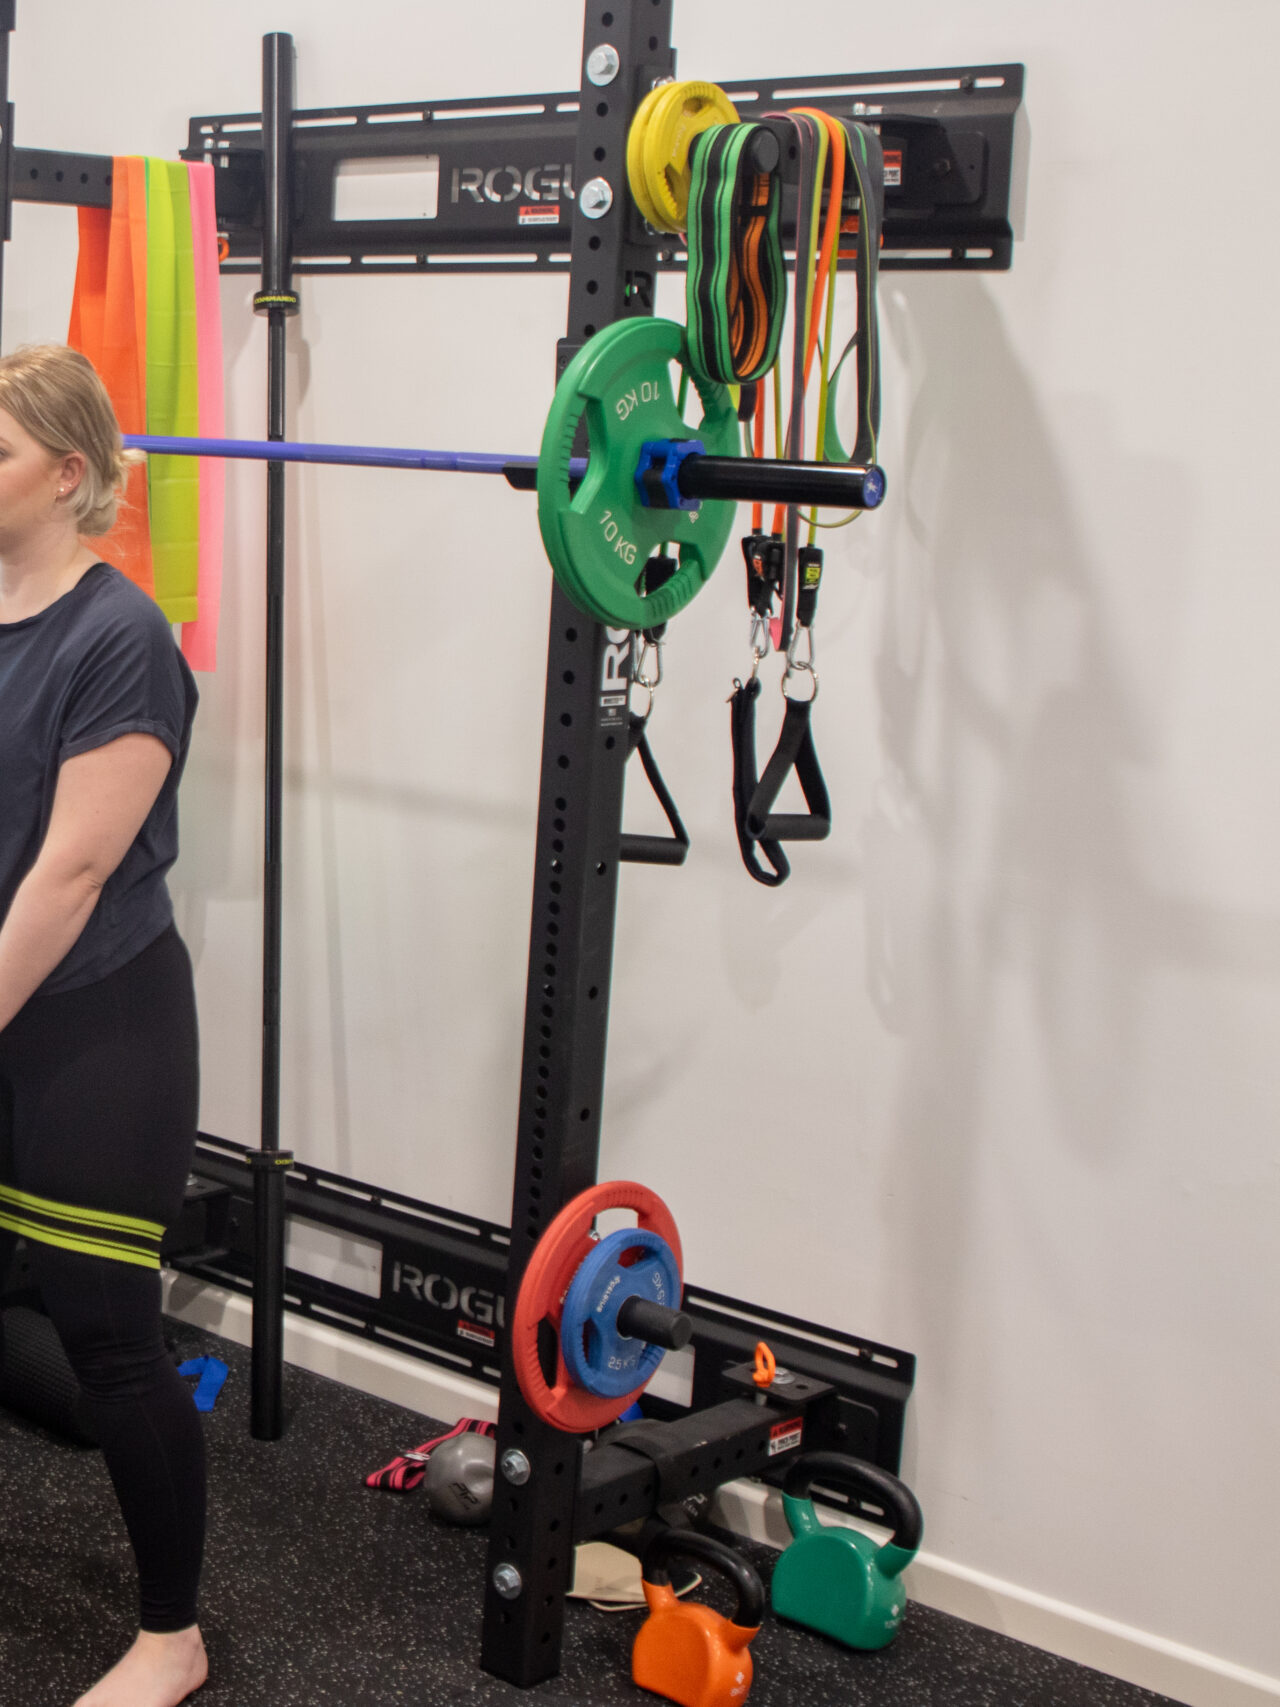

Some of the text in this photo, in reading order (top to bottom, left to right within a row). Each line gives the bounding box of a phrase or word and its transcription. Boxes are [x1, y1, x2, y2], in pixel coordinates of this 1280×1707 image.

[451, 164, 575, 203] ROG
[616, 381, 660, 421] 10 KG
[599, 510, 637, 565] 10 KG
[393, 1261, 505, 1328] ROG
